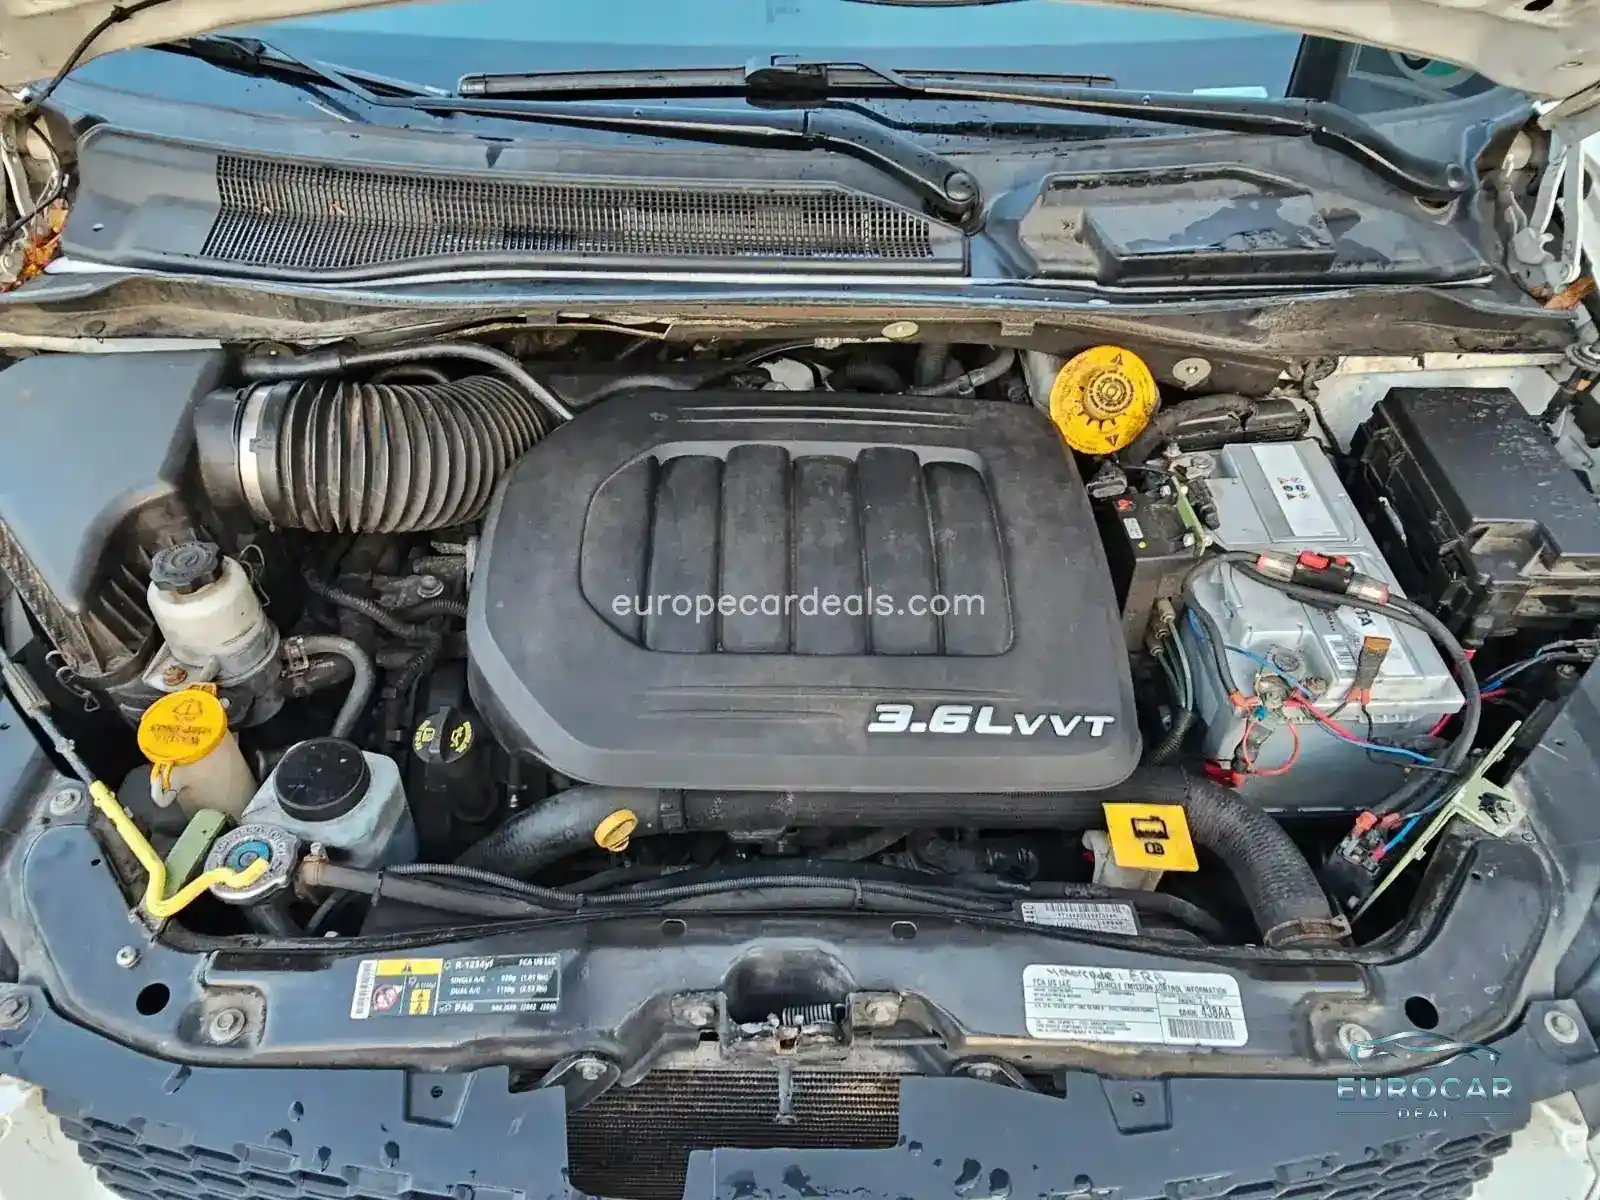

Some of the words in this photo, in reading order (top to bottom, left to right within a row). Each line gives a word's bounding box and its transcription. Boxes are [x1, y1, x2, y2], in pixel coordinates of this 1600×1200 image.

[1096, 980, 1122, 990] VEHICLE
[1123, 981, 1155, 991] EMISSION
[1184, 985, 1228, 994] INFORMATION
[454, 1003, 475, 1013] PAG
